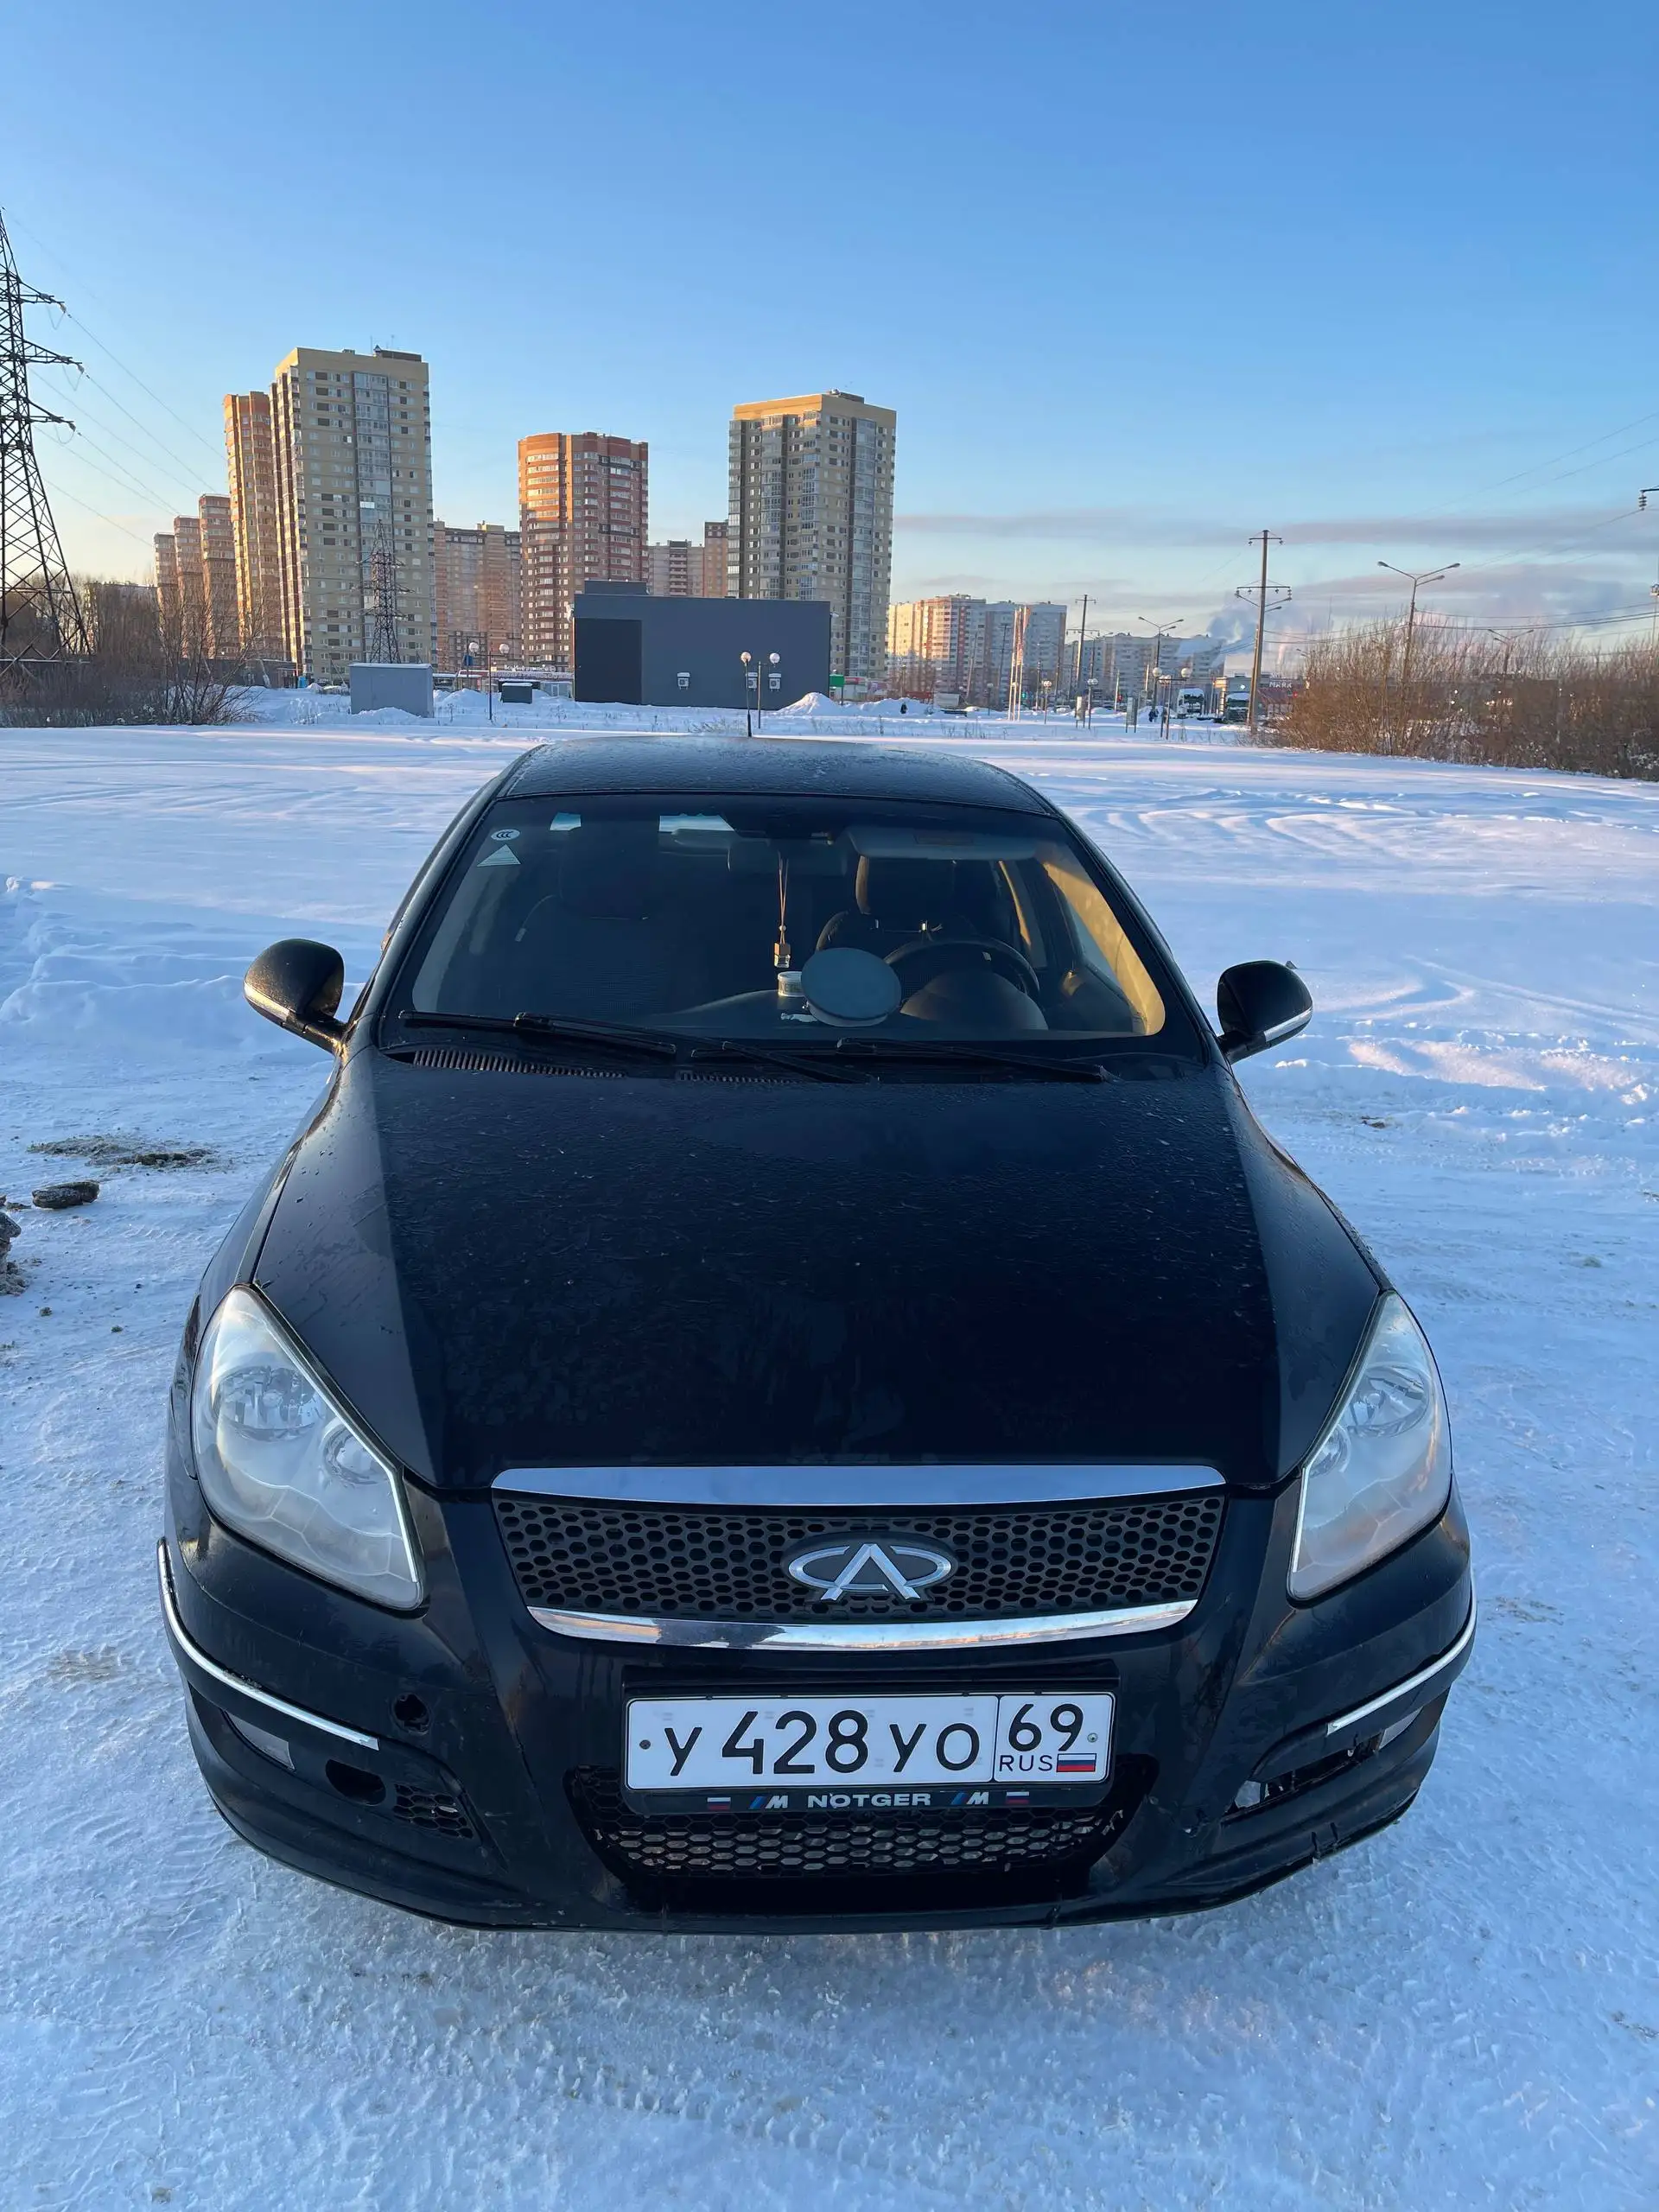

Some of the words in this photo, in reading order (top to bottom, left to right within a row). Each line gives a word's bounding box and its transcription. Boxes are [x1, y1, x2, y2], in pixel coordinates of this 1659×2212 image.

[721, 1709, 868, 1775] 428
[1007, 1703, 1084, 1752] 69
[998, 1754, 1053, 1772] RUS
[806, 1793, 932, 1808] NOTGER
